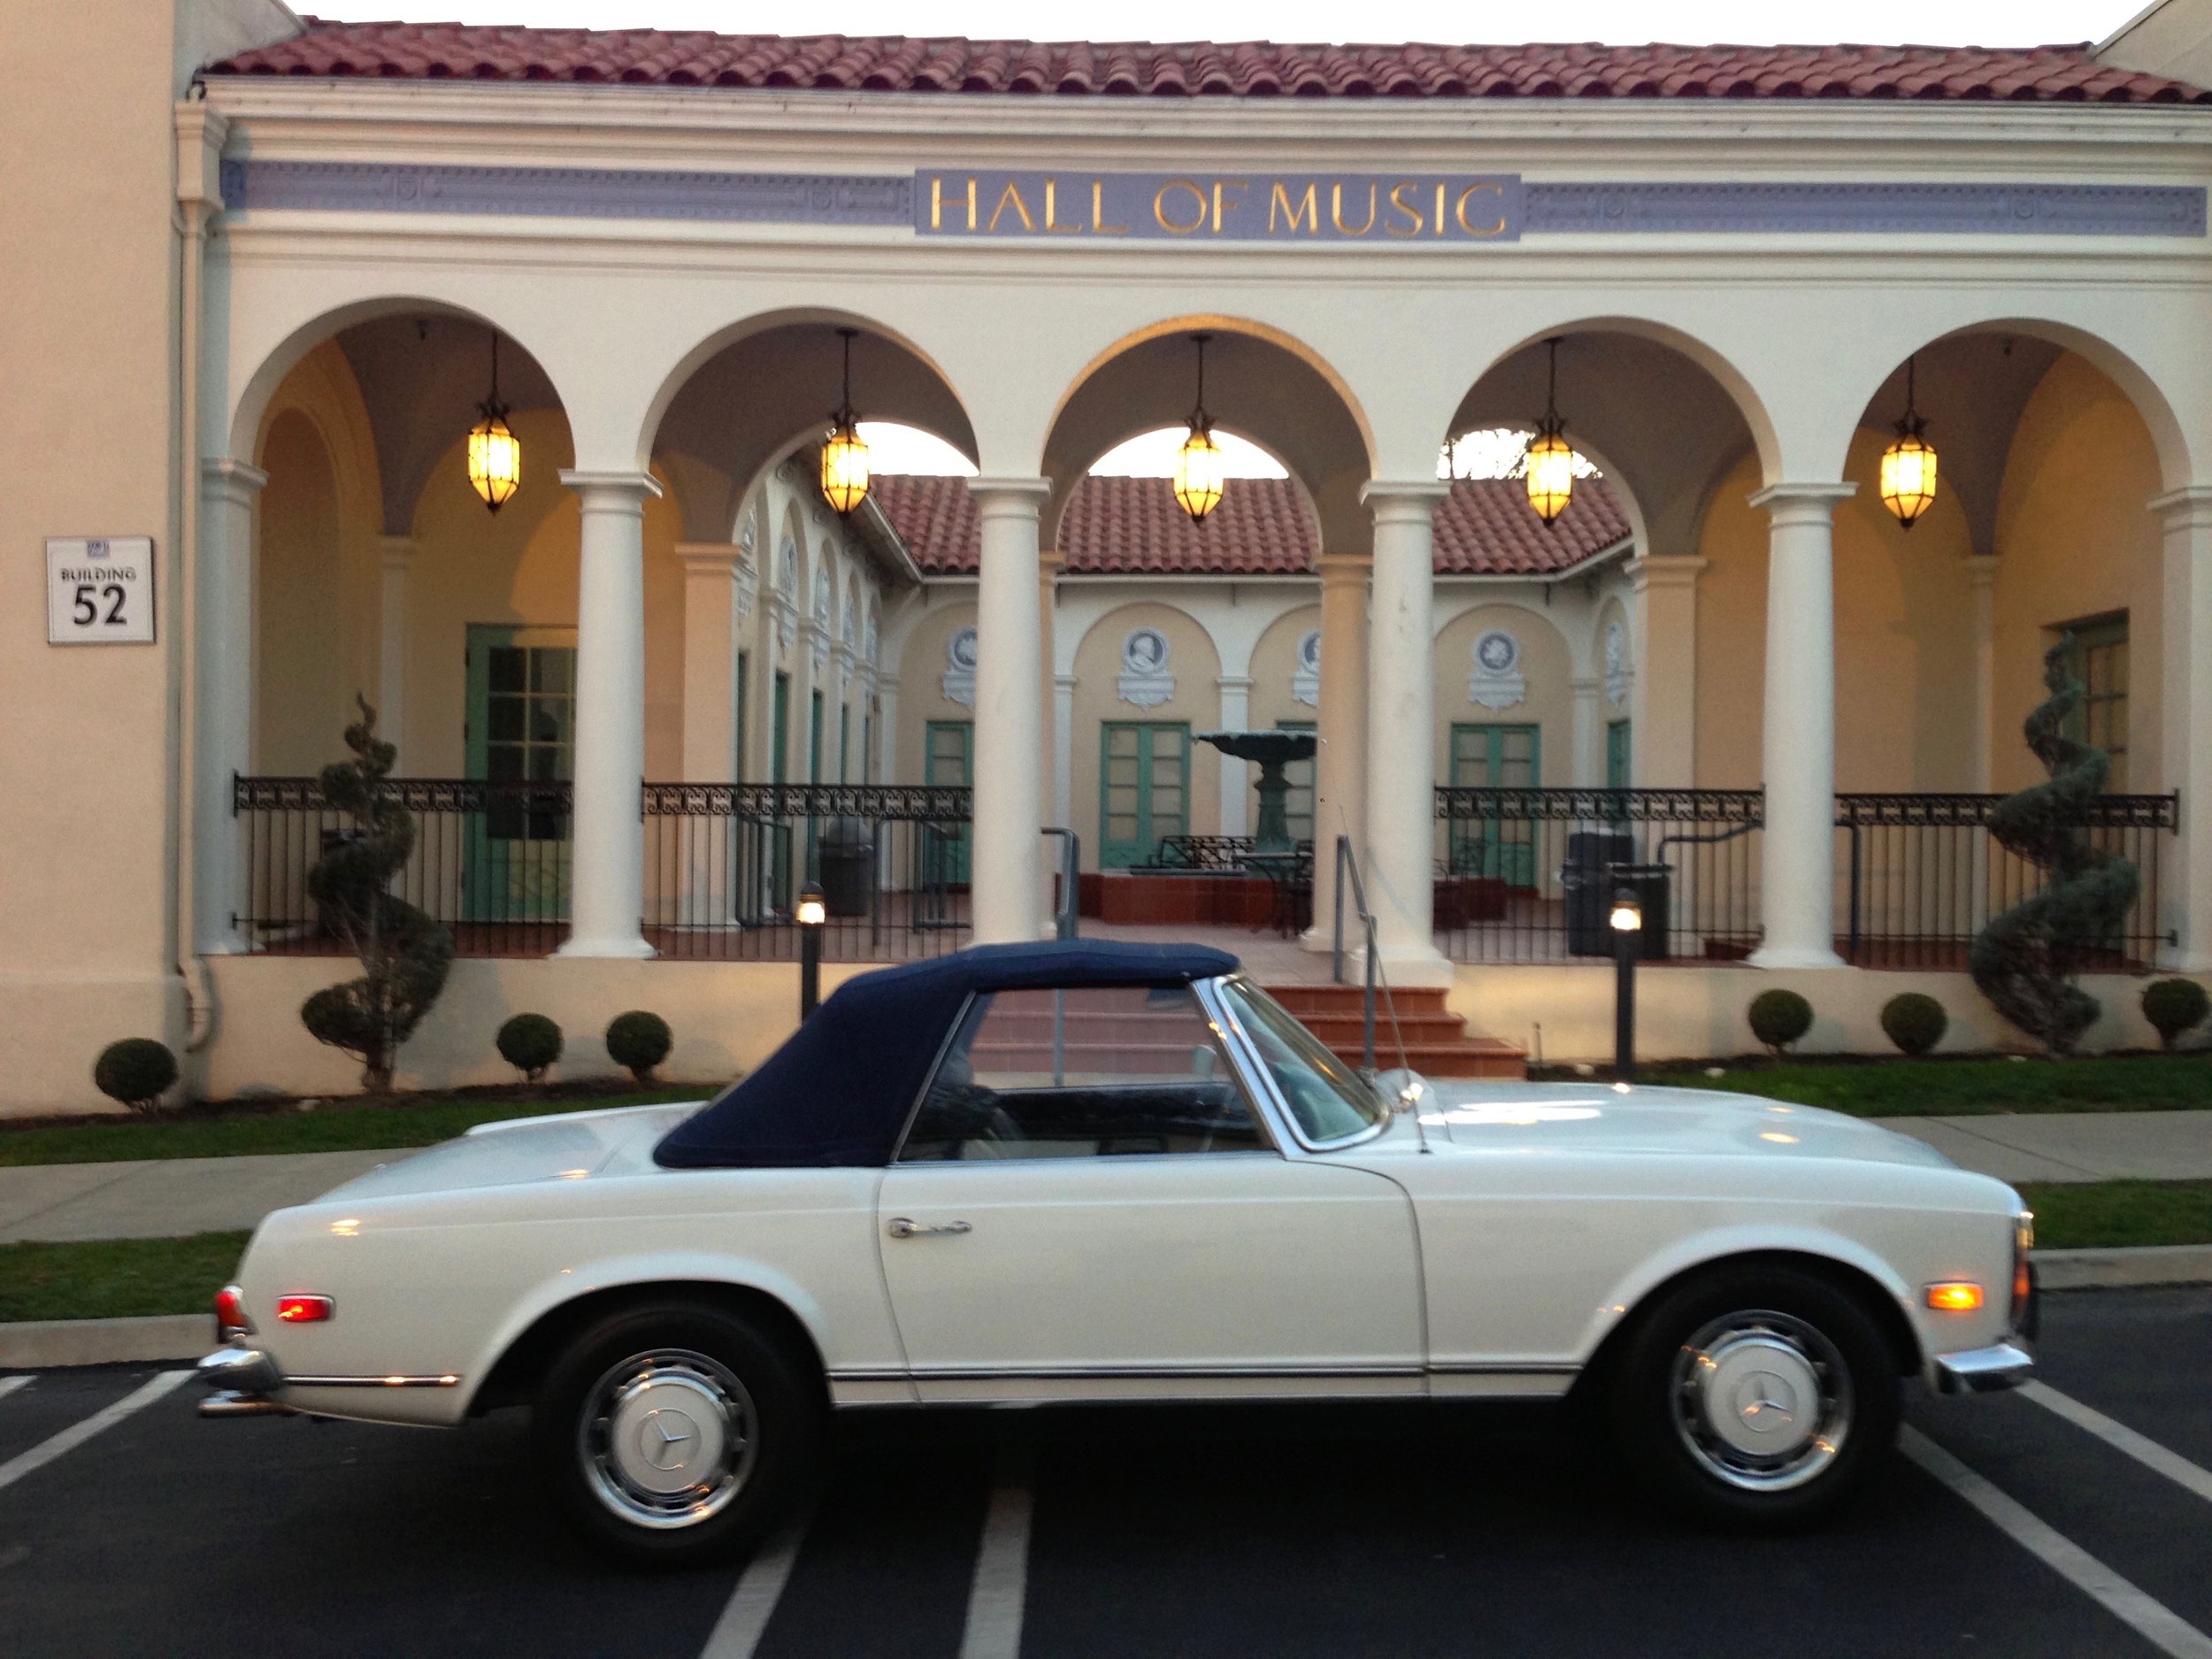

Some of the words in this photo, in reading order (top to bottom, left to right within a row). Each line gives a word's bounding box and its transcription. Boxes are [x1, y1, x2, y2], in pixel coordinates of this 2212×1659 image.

[932, 177, 1126, 234] HALL
[1155, 180, 1248, 234] OF
[1270, 181, 1504, 235] MUSIC
[60, 567, 137, 582] BUILDING
[73, 585, 127, 626] 52
